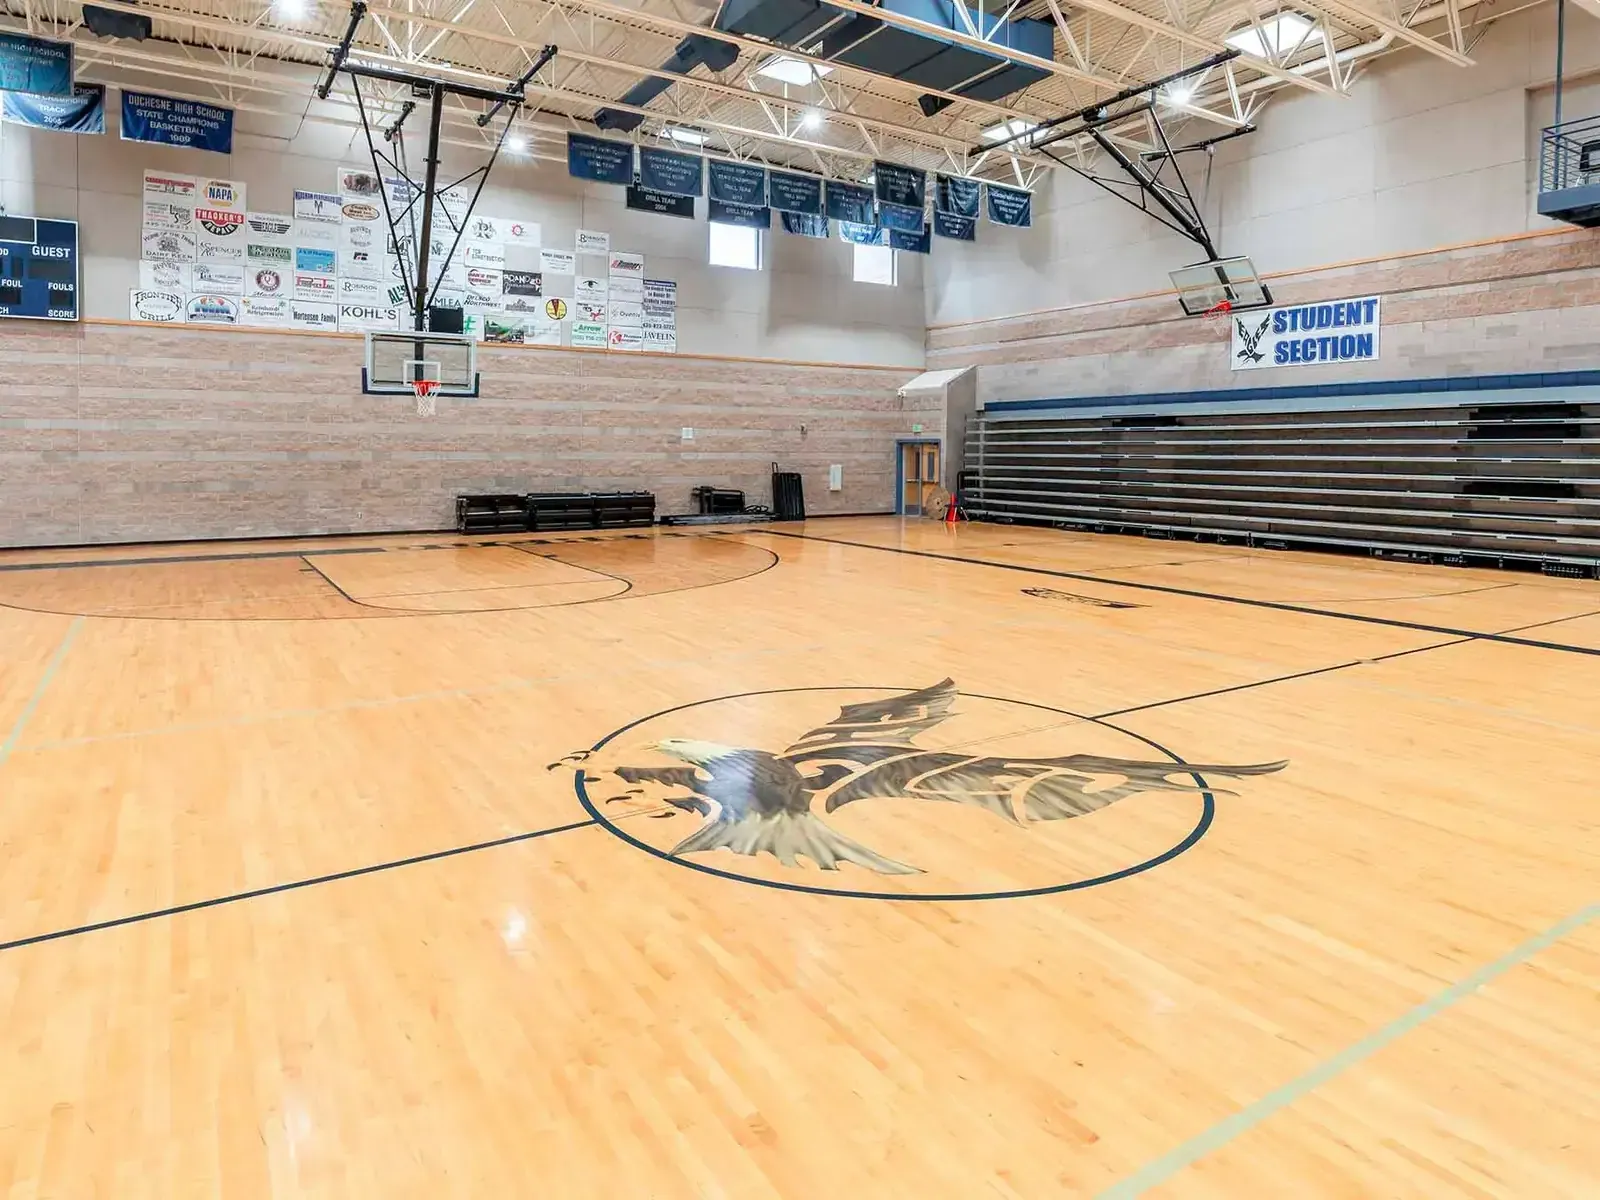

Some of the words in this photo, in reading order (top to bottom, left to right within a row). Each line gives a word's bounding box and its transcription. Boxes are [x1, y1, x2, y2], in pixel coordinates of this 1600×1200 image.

[128, 94, 171, 110] DUCHESNE
[174, 101, 193, 114] HIGH
[196, 106, 226, 121] SCHOOL
[136, 109, 163, 120] STATE
[168, 114, 219, 129] CHAMPIONS
[150, 121, 206, 136] BASKETBALL
[208, 187, 233, 201] NAPA
[205, 222, 235, 235] REPAIR
[32, 246, 71, 258] GUEST
[1, 279, 23, 288] FOUL
[48, 282, 74, 291] FOULS
[134, 290, 183, 309] FRONTIER
[48, 309, 75, 318] SCORE
[139, 310, 175, 321] GRILL
[320, 313, 336, 324] Family
[341, 305, 397, 320] KOHL'S
[1273, 298, 1378, 334] STUDENT
[1274, 333, 1374, 365] SECTION
